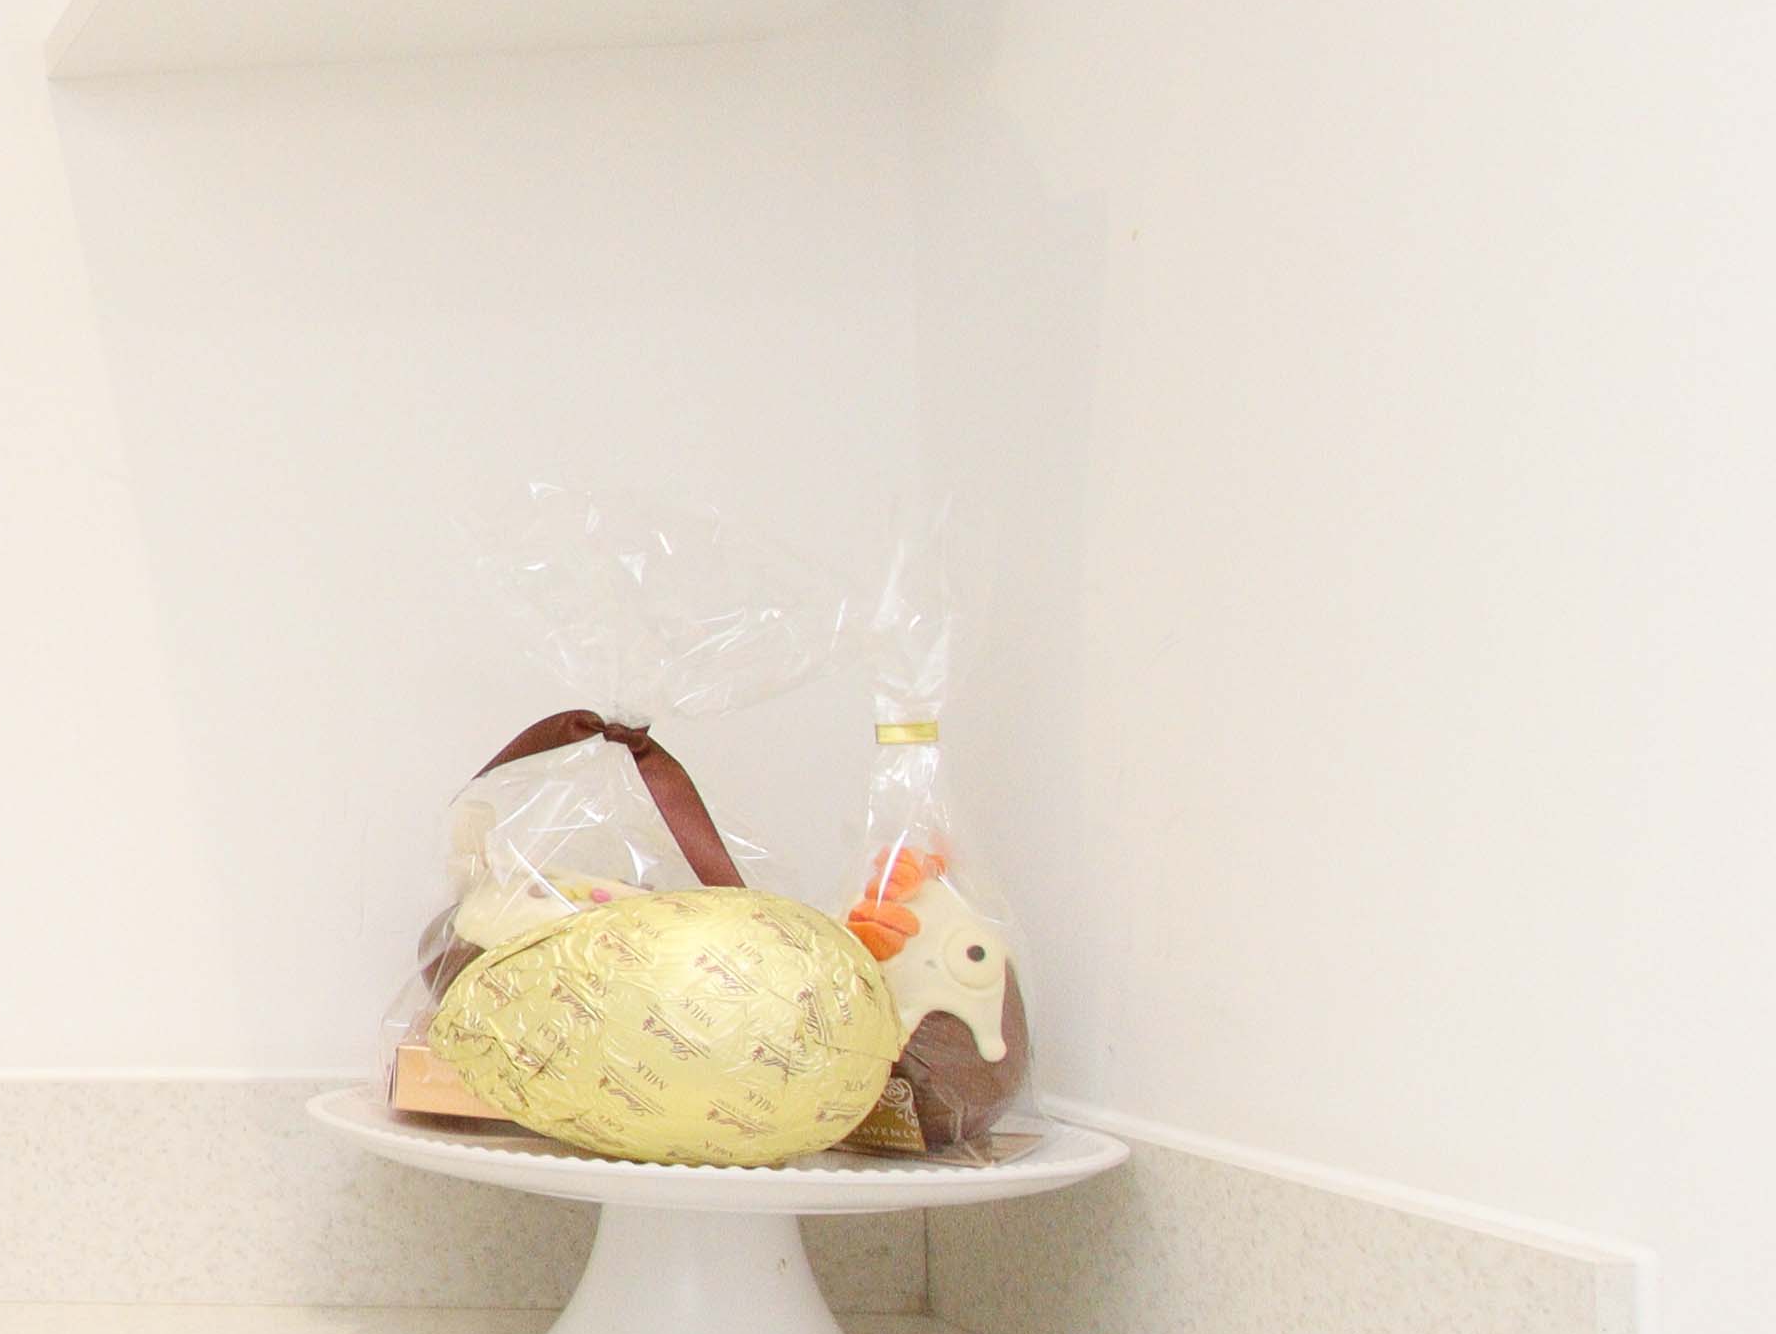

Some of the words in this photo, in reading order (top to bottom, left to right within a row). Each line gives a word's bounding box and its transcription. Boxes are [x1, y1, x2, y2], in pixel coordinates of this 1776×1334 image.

[679, 996, 717, 1028] MILK
[648, 1027, 695, 1062] Lindt
[631, 1060, 669, 1092] MILK
